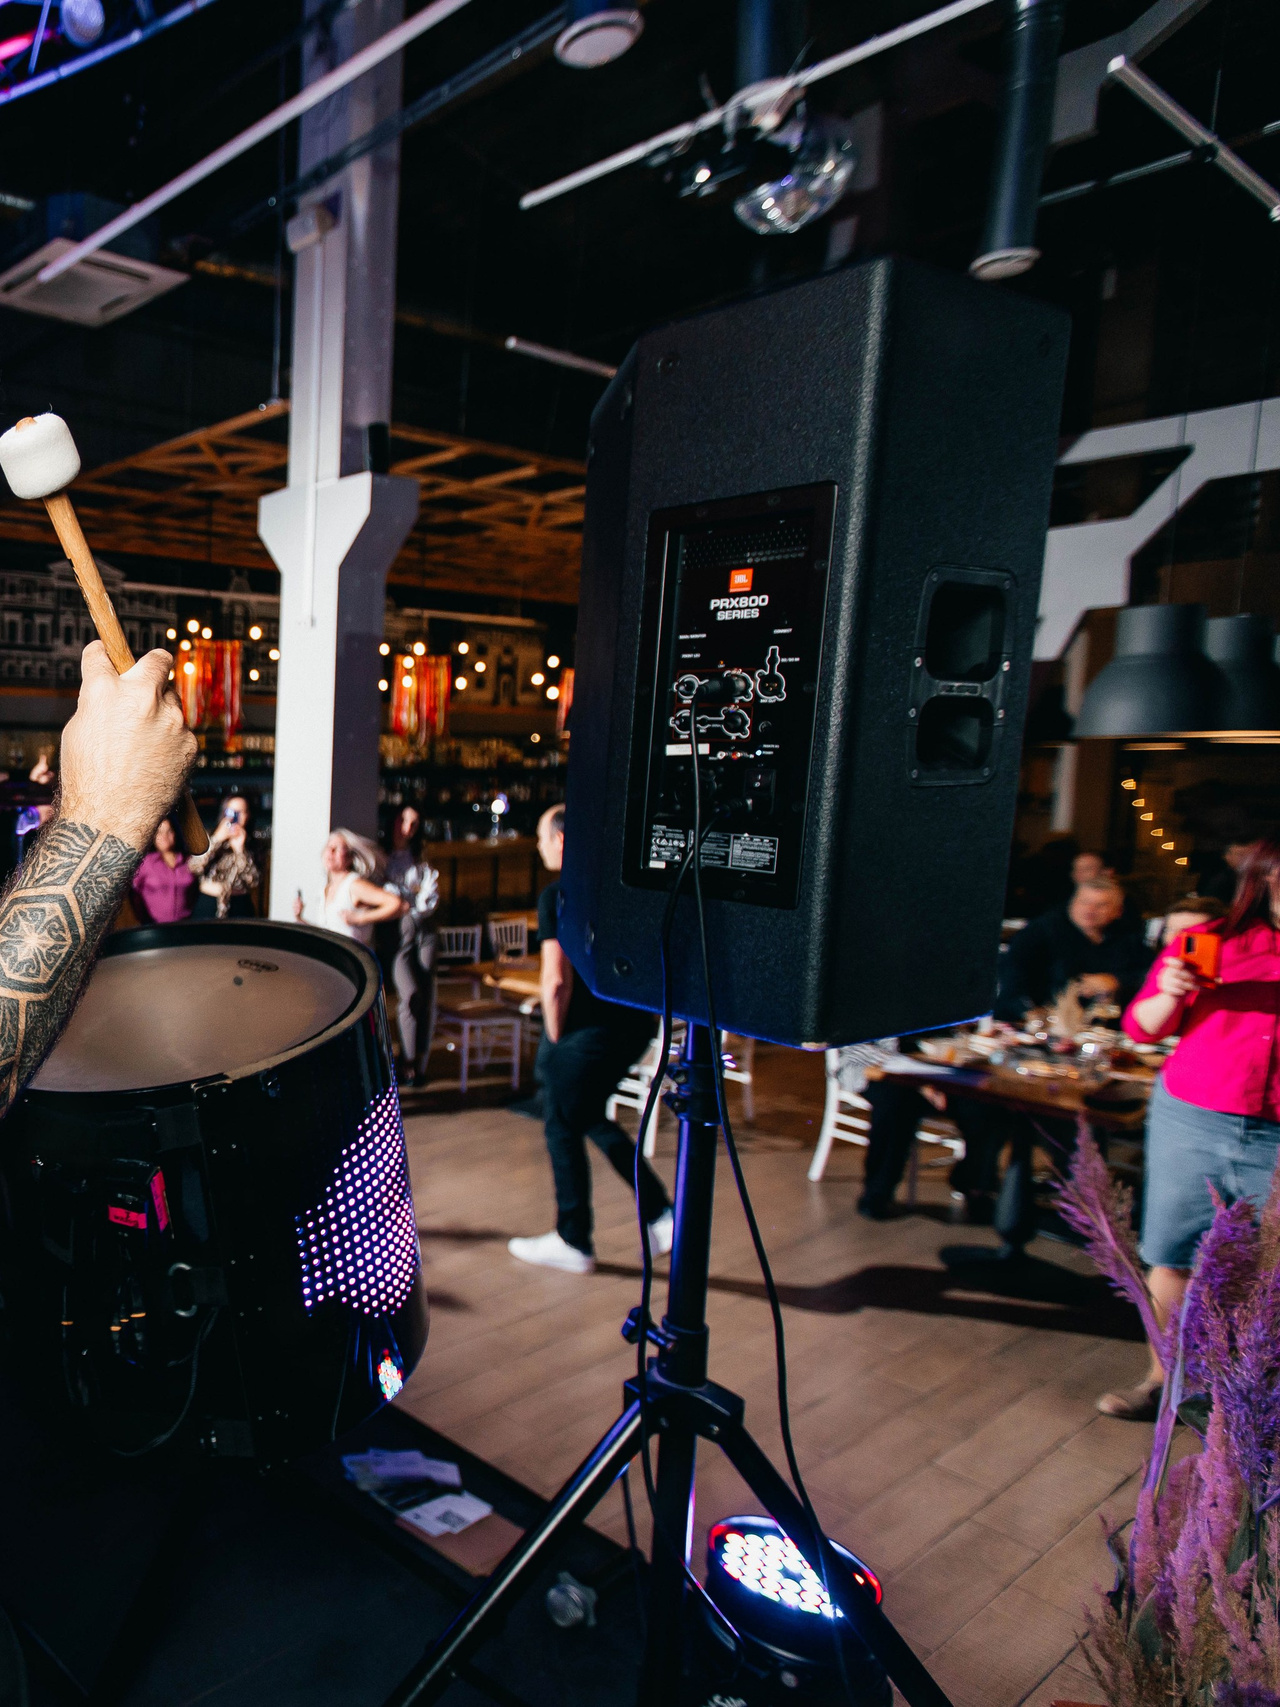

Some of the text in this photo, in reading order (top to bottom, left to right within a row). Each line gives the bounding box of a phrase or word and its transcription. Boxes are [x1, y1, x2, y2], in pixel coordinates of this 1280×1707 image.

[734, 574, 748, 584] JBL
[709, 594, 769, 610] PRX800
[716, 608, 760, 621] SERIES
